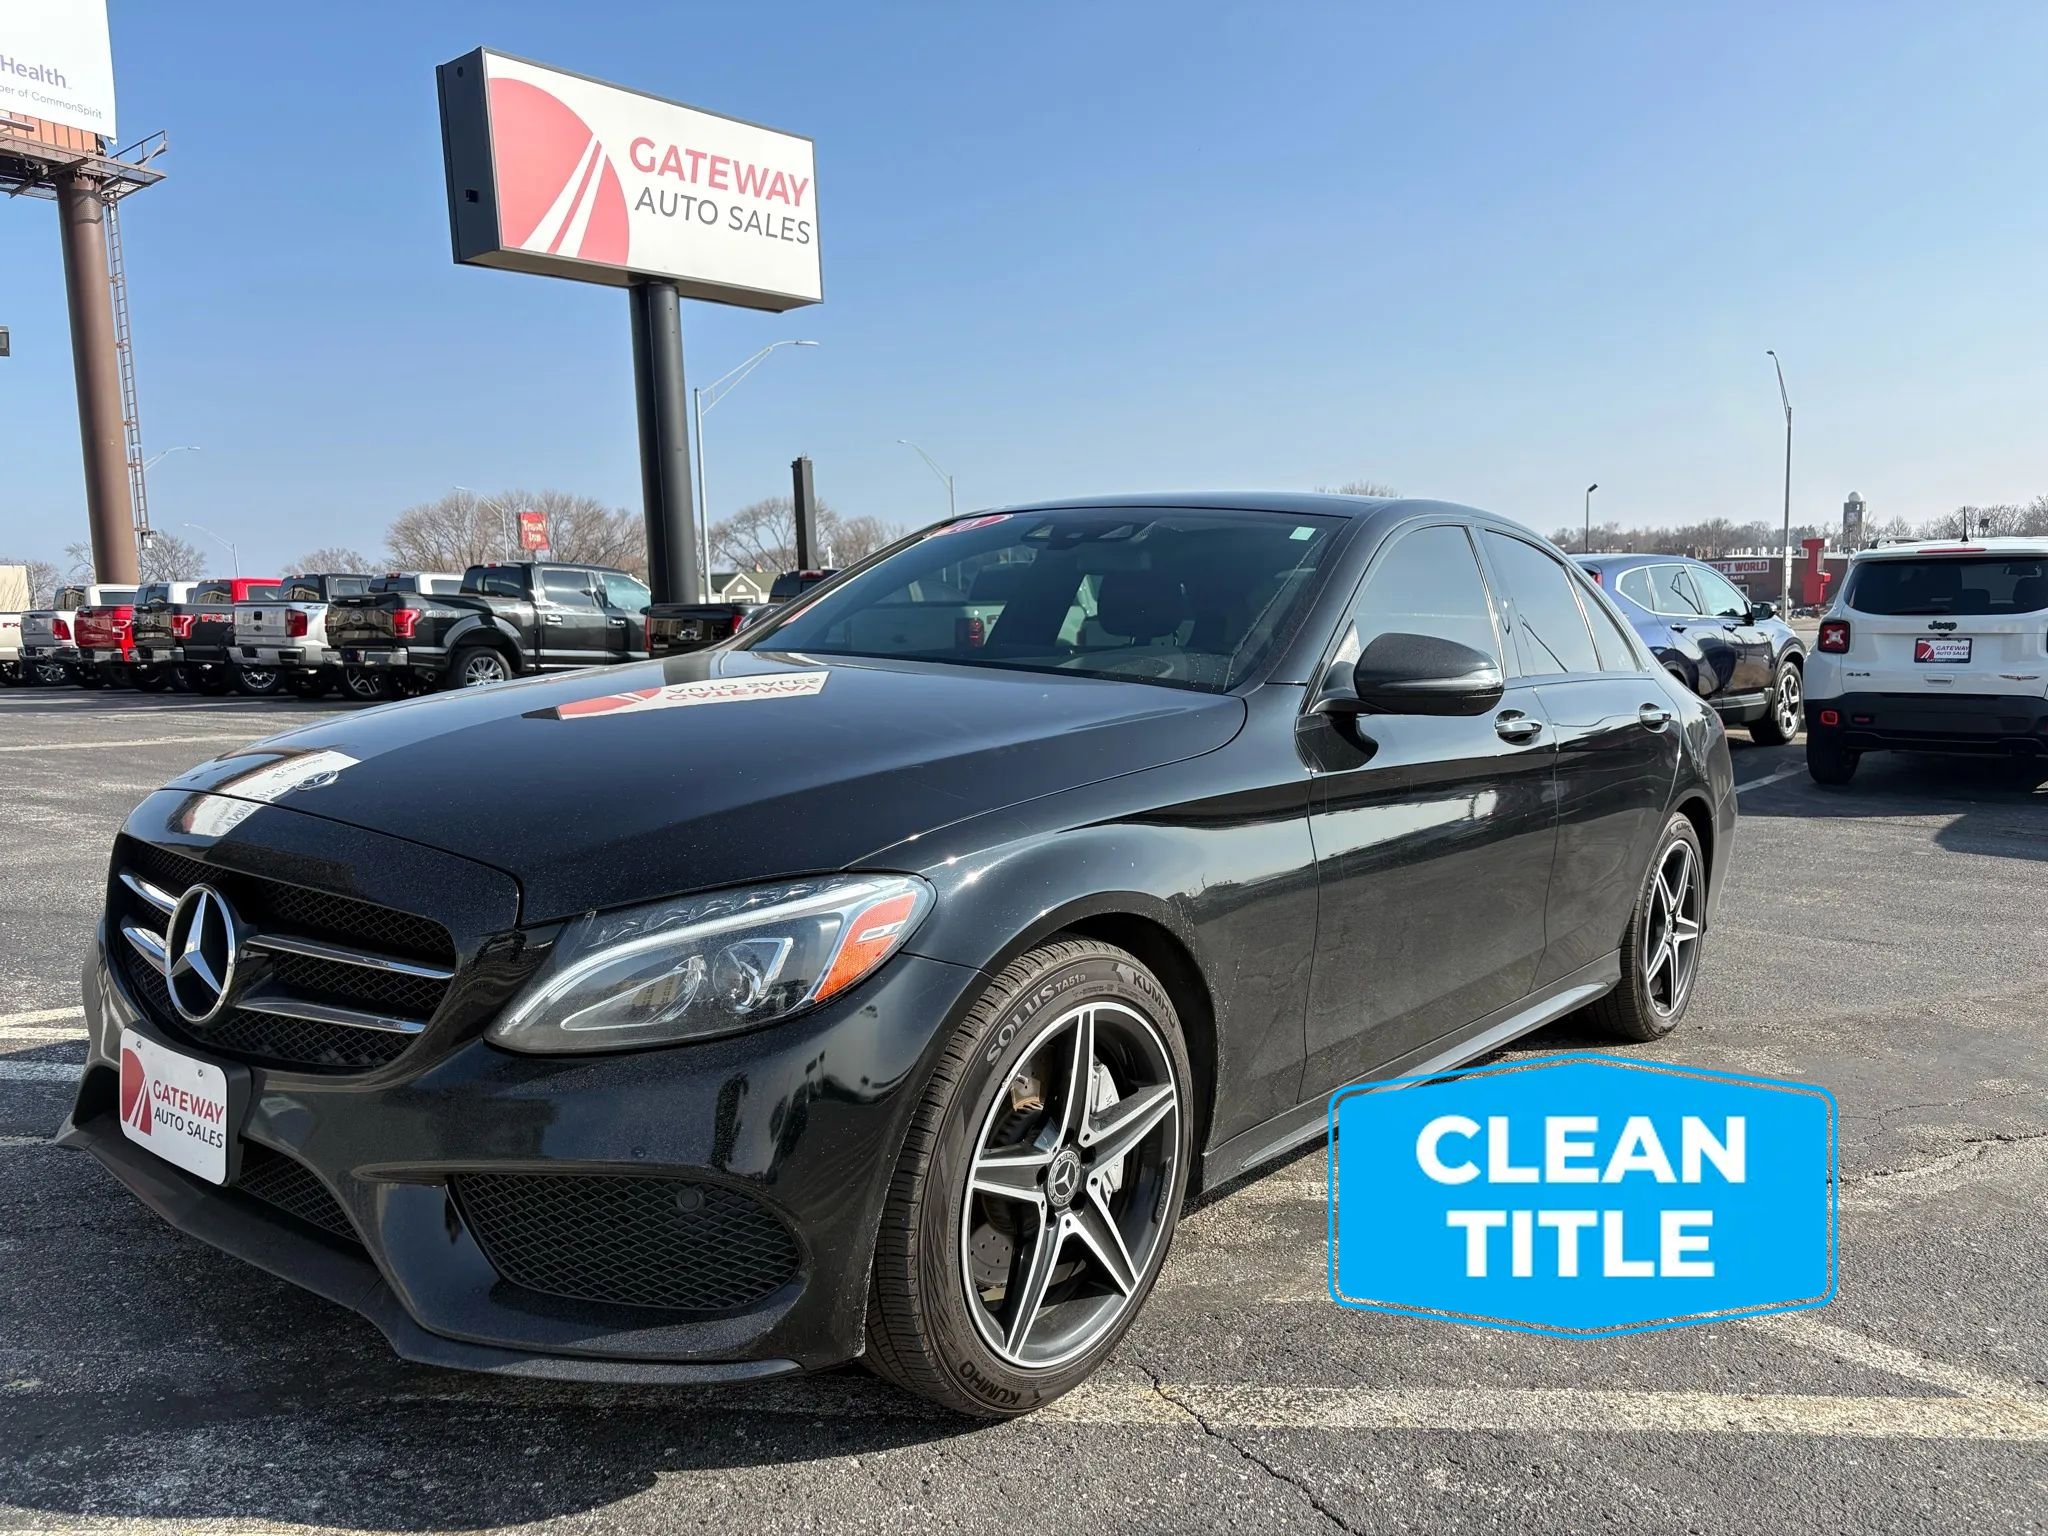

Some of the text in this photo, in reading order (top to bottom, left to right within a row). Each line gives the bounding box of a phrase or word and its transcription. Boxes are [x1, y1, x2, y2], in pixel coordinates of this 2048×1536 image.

[0, 54, 66, 88] Health
[18, 88, 28, 98] of
[31, 91, 102, 119] CommonSpirit
[629, 136, 809, 207] GATEWAY
[634, 186, 811, 245] AUTO SALES
[1709, 560, 1768, 573] RIFT WORLD
[1927, 620, 1958, 631] Jeep
[1132, 970, 1177, 1029] KUMHO
[986, 983, 1056, 1066] SOLUS
[152, 1079, 224, 1125] GATEWAY
[154, 1106, 223, 1149] AUTO SALES
[958, 1360, 1021, 1406] KUMHO
